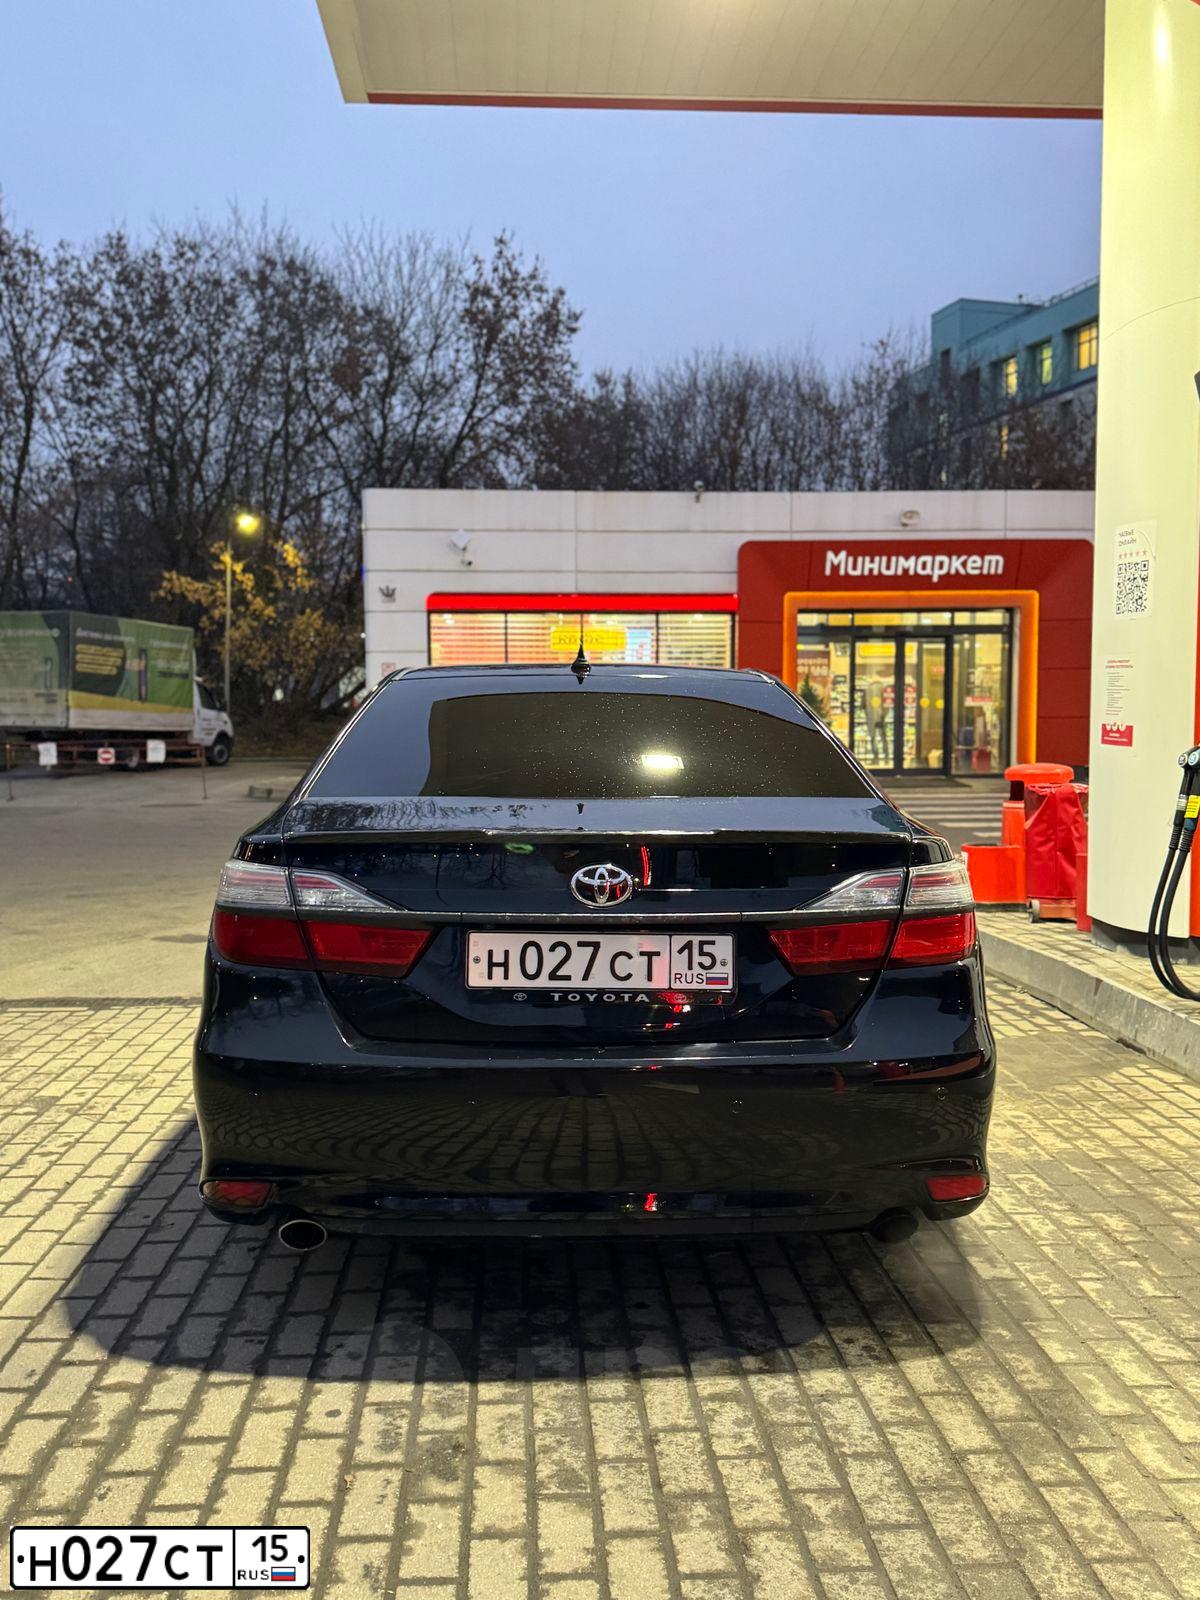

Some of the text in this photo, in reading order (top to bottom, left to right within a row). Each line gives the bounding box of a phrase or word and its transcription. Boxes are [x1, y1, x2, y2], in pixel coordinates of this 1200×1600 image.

[825, 550, 1004, 583] Минимаркет
[677, 940, 717, 970] 15
[674, 973, 704, 984] RUS
[550, 992, 650, 1002] TOYOTA
